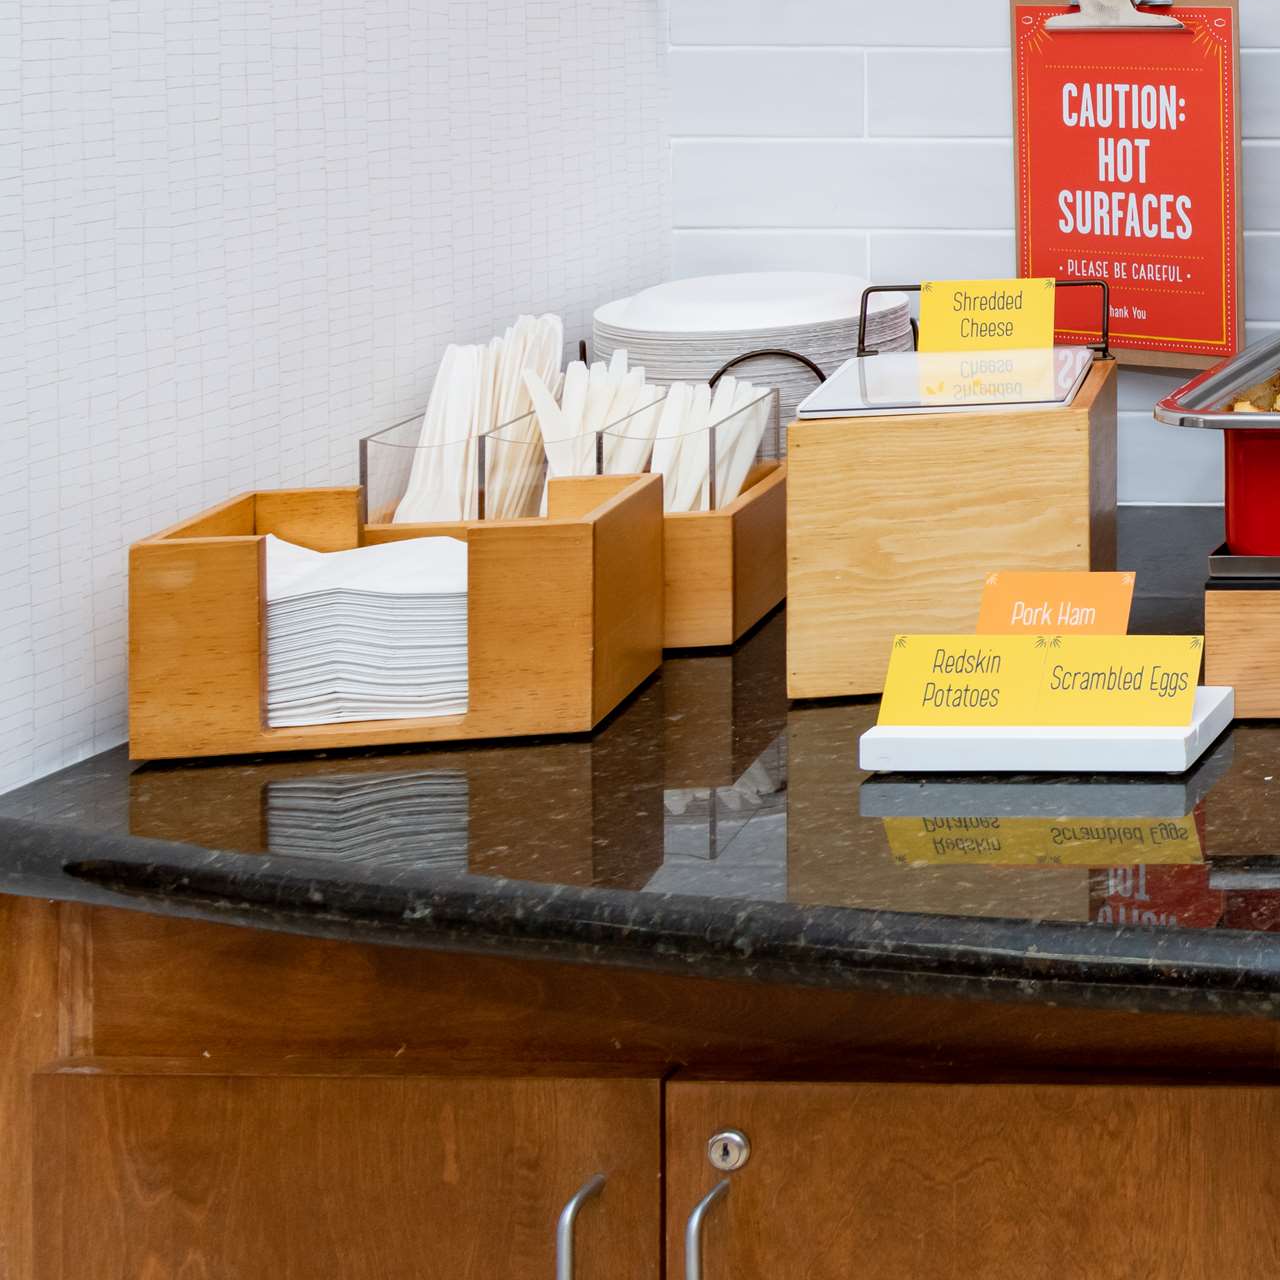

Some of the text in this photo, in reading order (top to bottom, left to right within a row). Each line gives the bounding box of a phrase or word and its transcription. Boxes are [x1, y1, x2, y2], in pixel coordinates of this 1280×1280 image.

[1062, 82, 1186, 130] CAUTION:
[1098, 137, 1151, 184] HOT
[1057, 189, 1193, 240] SURFACES
[1067, 259, 1183, 283] PLEASE BE CAREFUL
[953, 290, 1023, 312] Shredded
[1109, 304, 1147, 320] hank You
[960, 318, 1014, 338] Cheese
[1010, 601, 1096, 626] Pork Ham
[932, 648, 1001, 674] Redskin
[1050, 665, 1189, 698] Scrambled Eggs
[922, 682, 1000, 708] Potatoes
